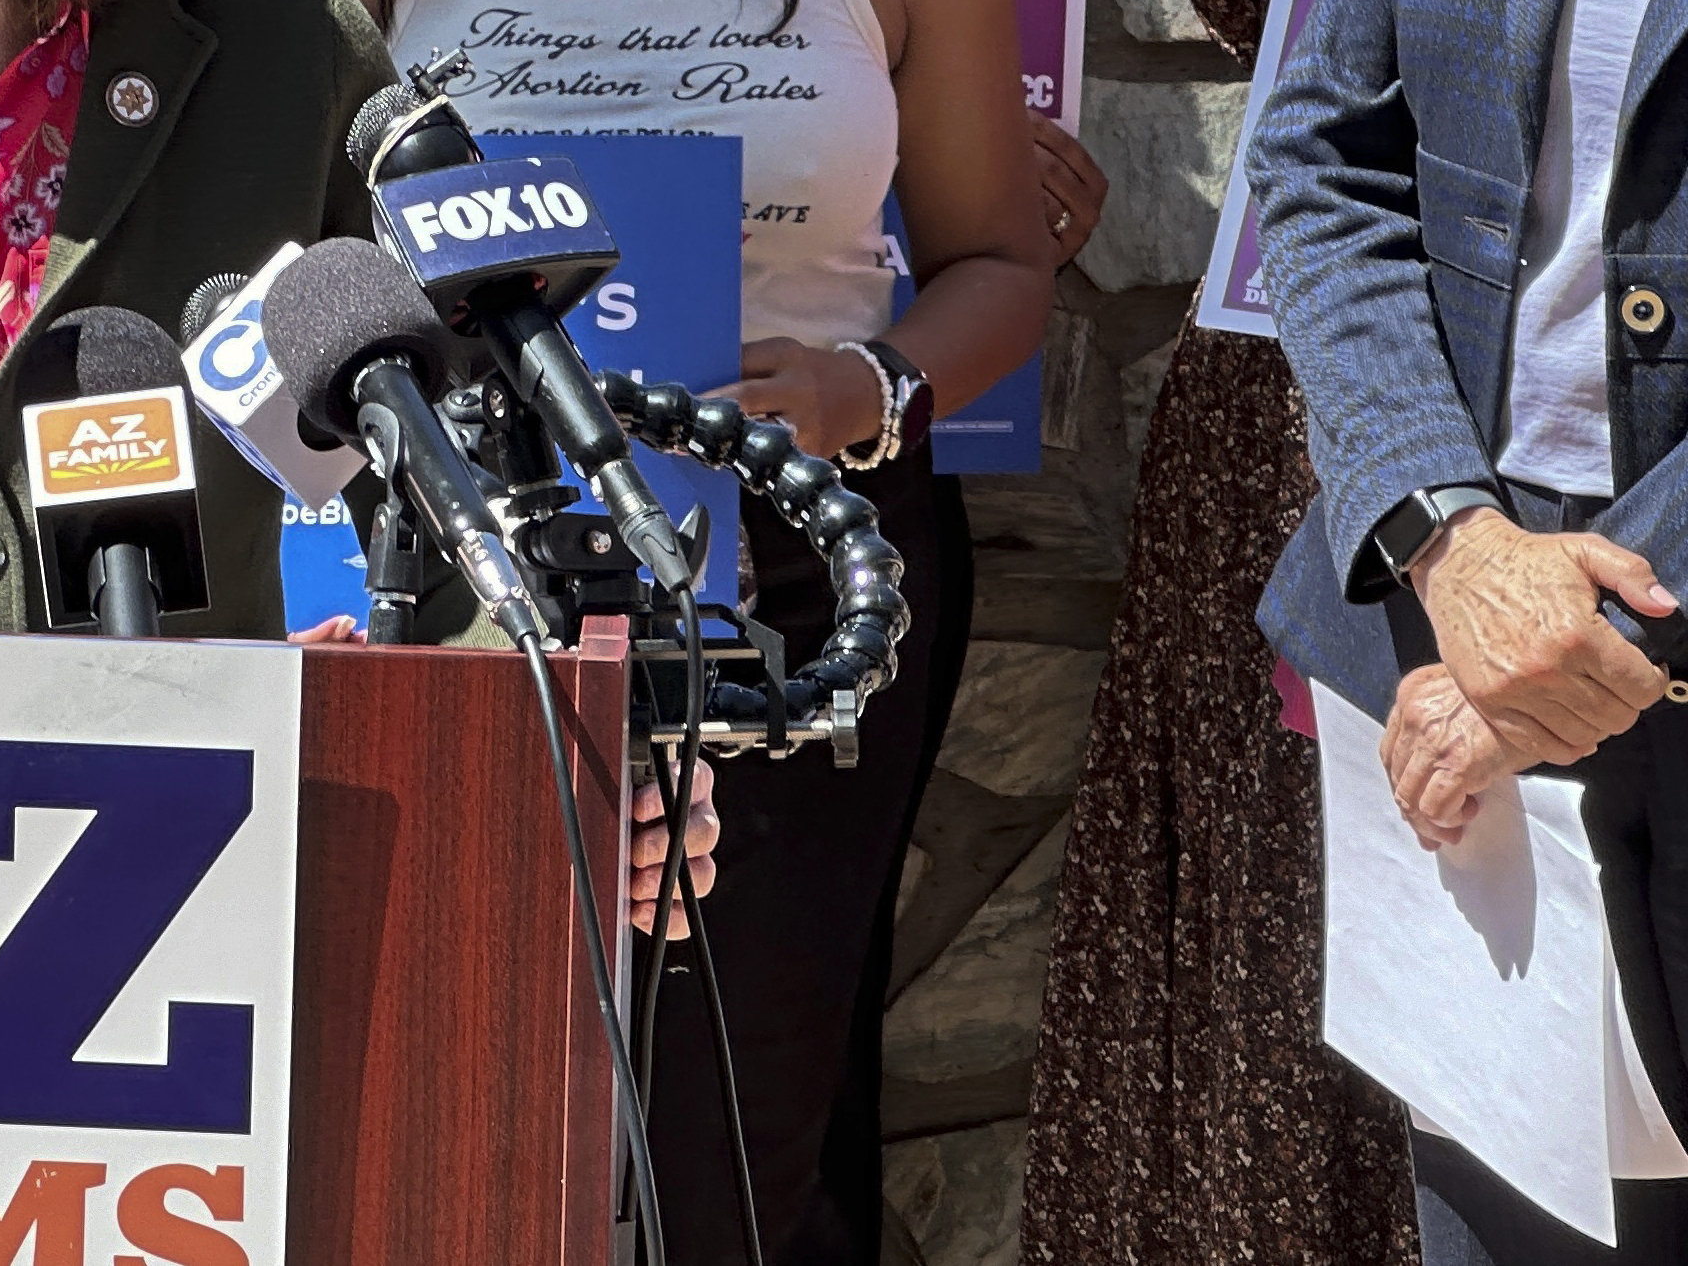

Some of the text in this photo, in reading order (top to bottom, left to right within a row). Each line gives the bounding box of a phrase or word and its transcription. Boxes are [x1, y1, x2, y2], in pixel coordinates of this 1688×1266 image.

[460, 8, 813, 59] Things that lower
[443, 60, 824, 104] Abortion Rates
[68, 413, 147, 447] AZ
[48, 438, 167, 469] FAMILY
